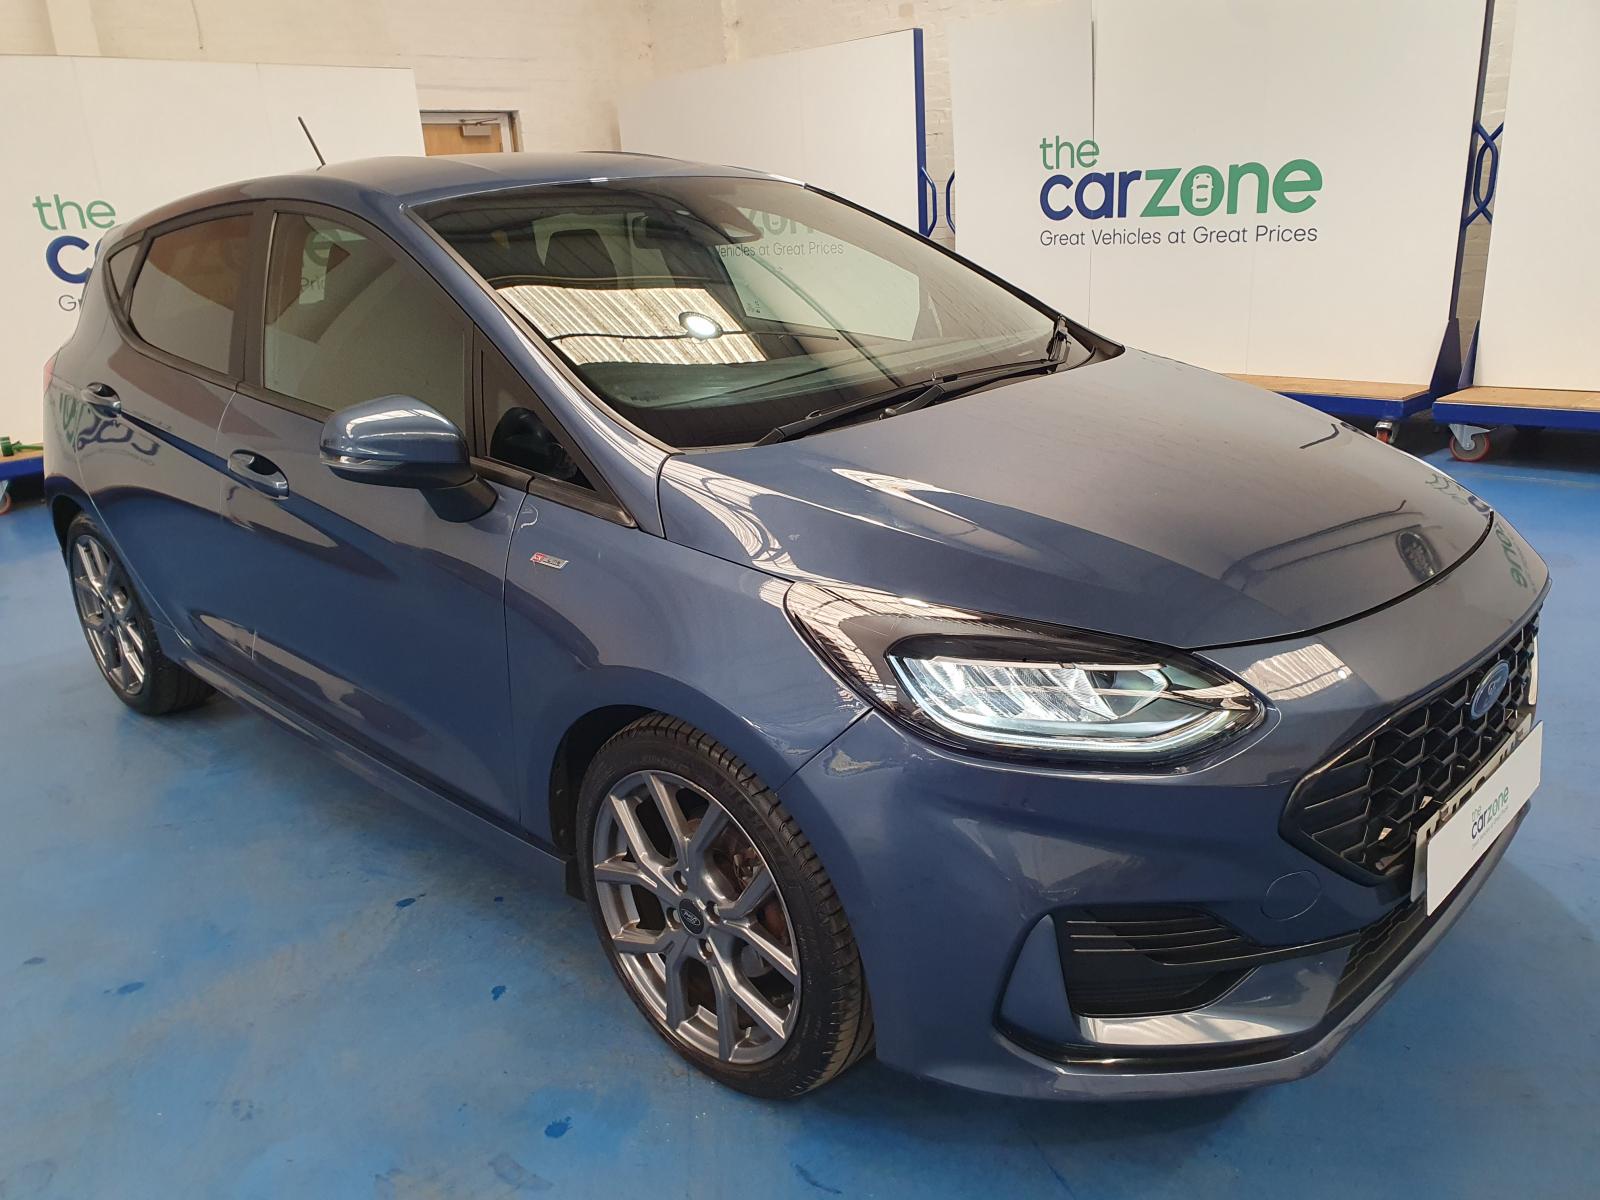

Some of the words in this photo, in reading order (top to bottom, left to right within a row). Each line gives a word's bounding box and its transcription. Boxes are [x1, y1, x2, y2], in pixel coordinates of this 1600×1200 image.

[1039, 135, 1100, 170] the
[1039, 158, 1323, 221] carzone
[32, 194, 116, 231] the
[758, 245, 770, 256] at
[773, 242, 805, 256] Great
[808, 241, 844, 256] Prices
[1040, 229, 1086, 246] Great
[1092, 228, 1161, 246] Vehicles
[1167, 228, 1187, 244] at
[1192, 226, 1248, 243] Great
[1255, 225, 1318, 242] Prices
[1471, 786, 1509, 840] carzone
